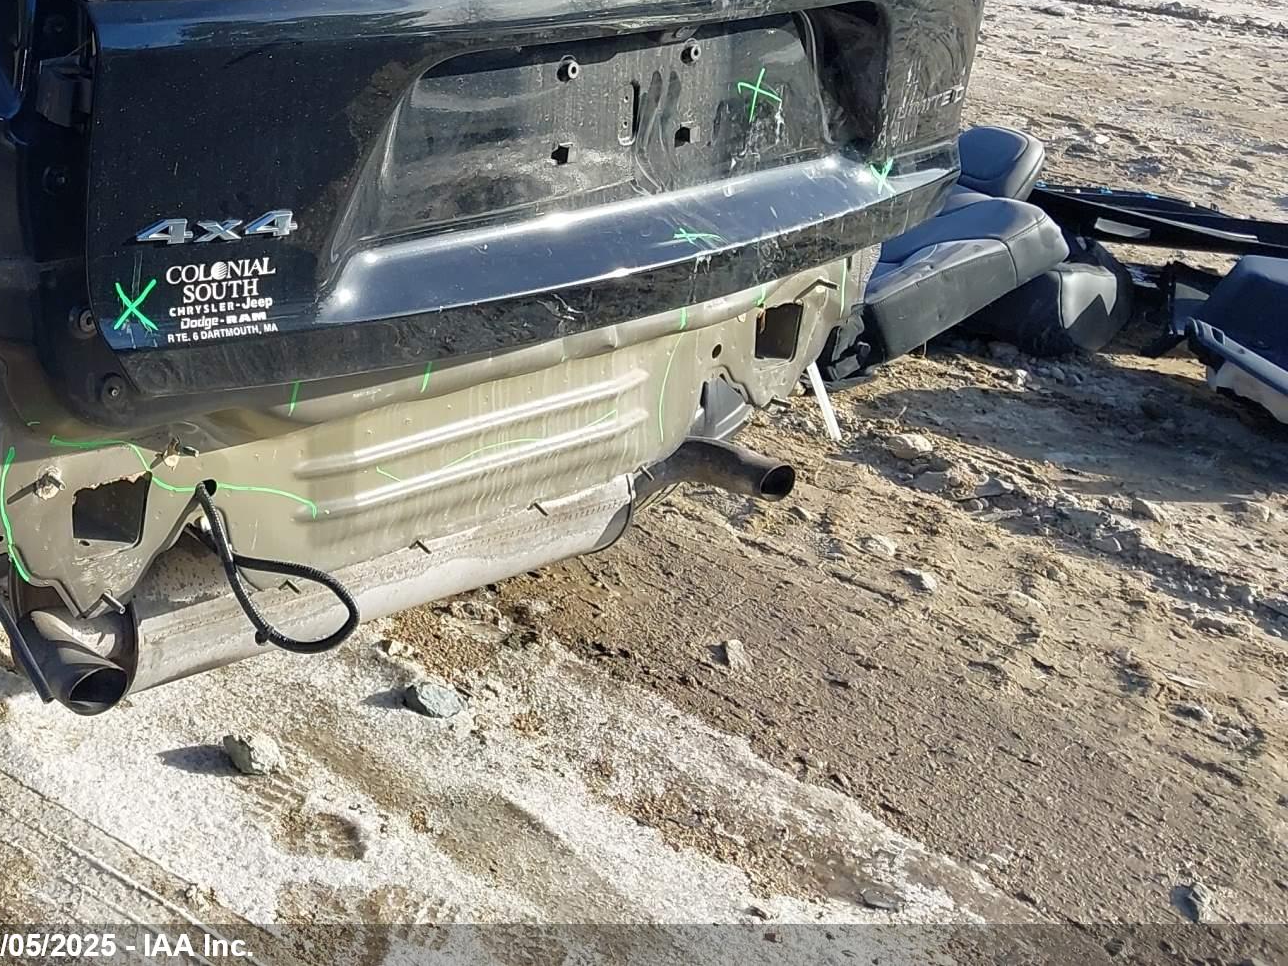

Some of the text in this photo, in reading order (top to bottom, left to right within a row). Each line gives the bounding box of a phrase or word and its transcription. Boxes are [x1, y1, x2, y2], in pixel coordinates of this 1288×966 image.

[135, 208, 298, 245] 4x4
[166, 257, 276, 284] COLONIAL
[183, 278, 259, 303] SOUTH
[193, 332, 199, 341] 6
[200, 325, 262, 340] DARTMOUTH,
[263, 323, 279, 333] MA
